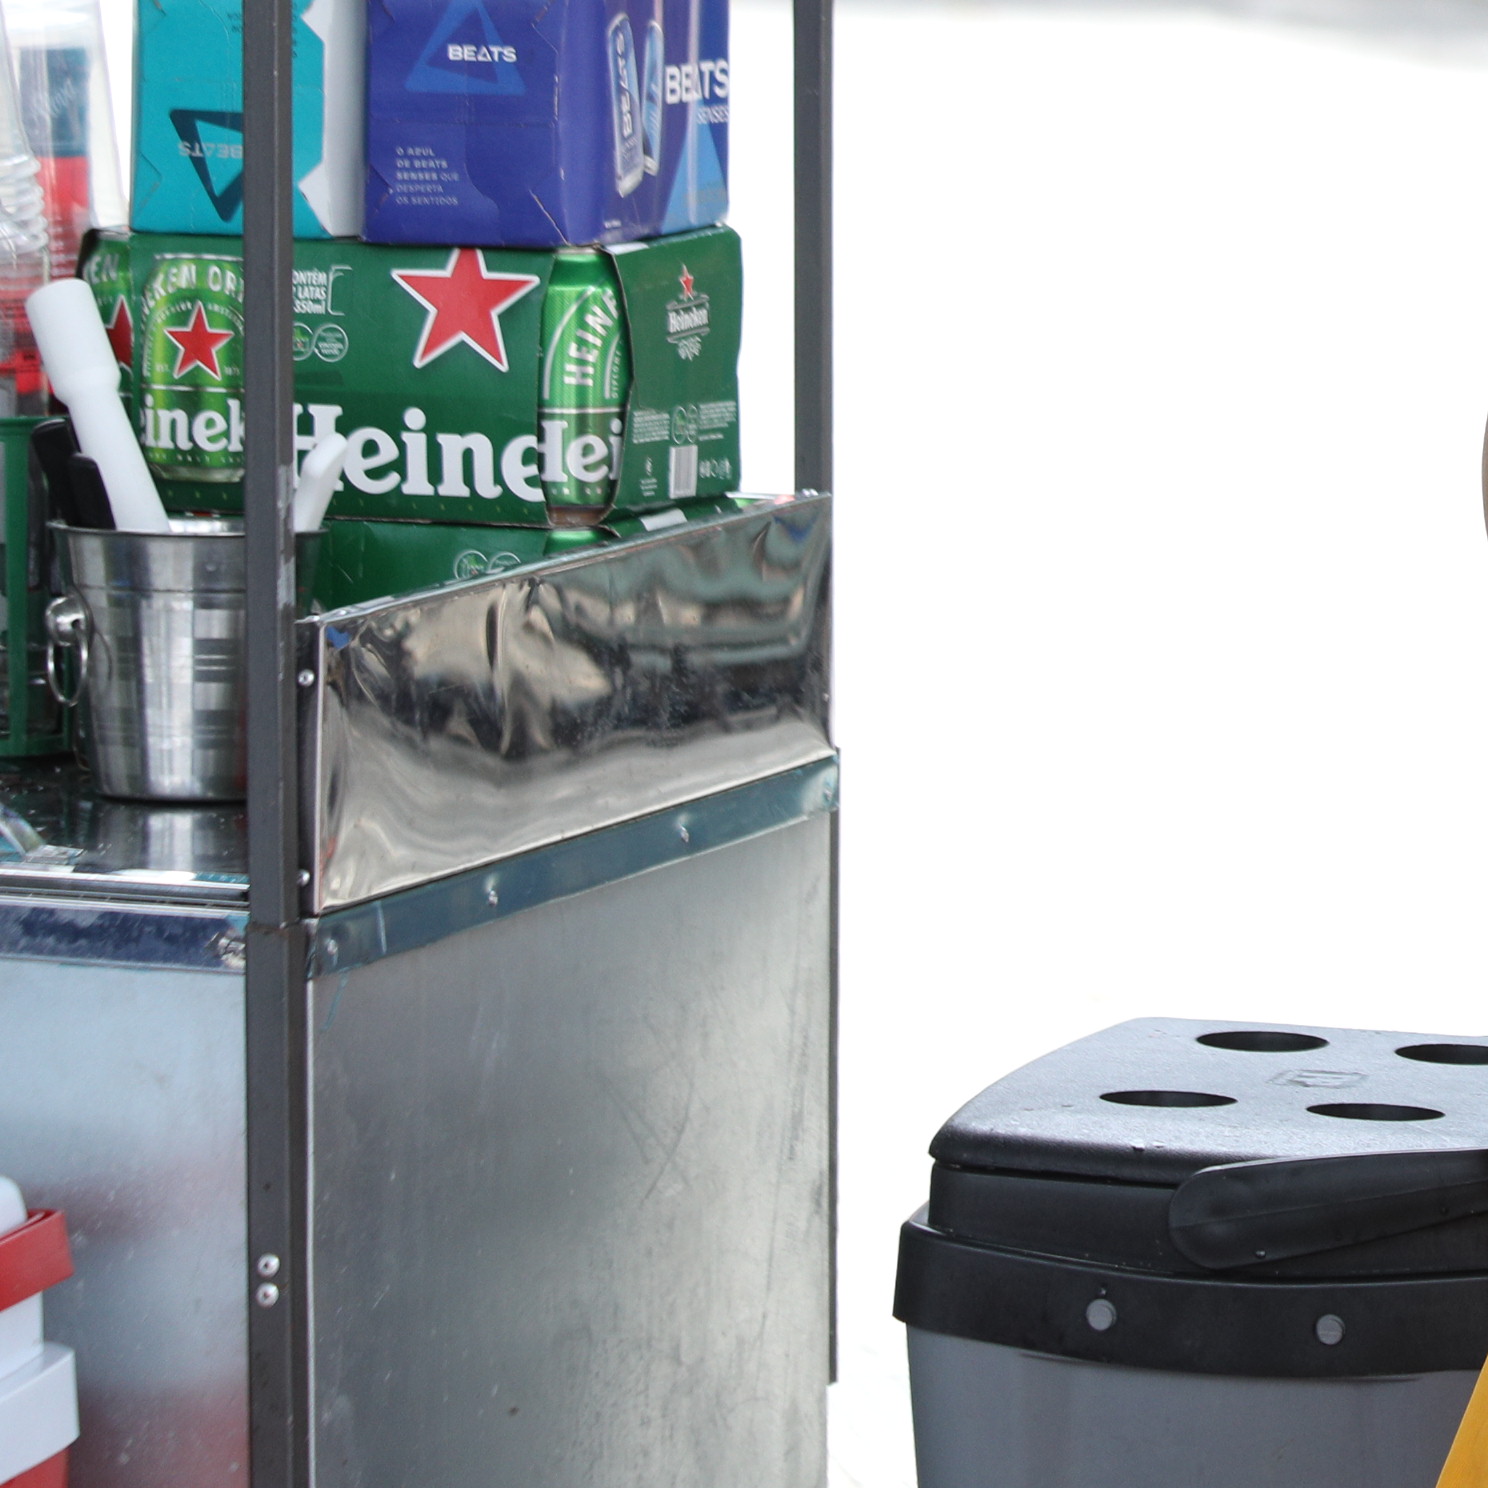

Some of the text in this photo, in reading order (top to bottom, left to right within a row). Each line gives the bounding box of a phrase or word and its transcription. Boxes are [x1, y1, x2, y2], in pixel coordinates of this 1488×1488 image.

[447, 43, 517, 63] BEATS
[664, 58, 729, 104] BEATS
[413, 158, 448, 169] BEATS
[298, 285, 327, 300] LATAS
